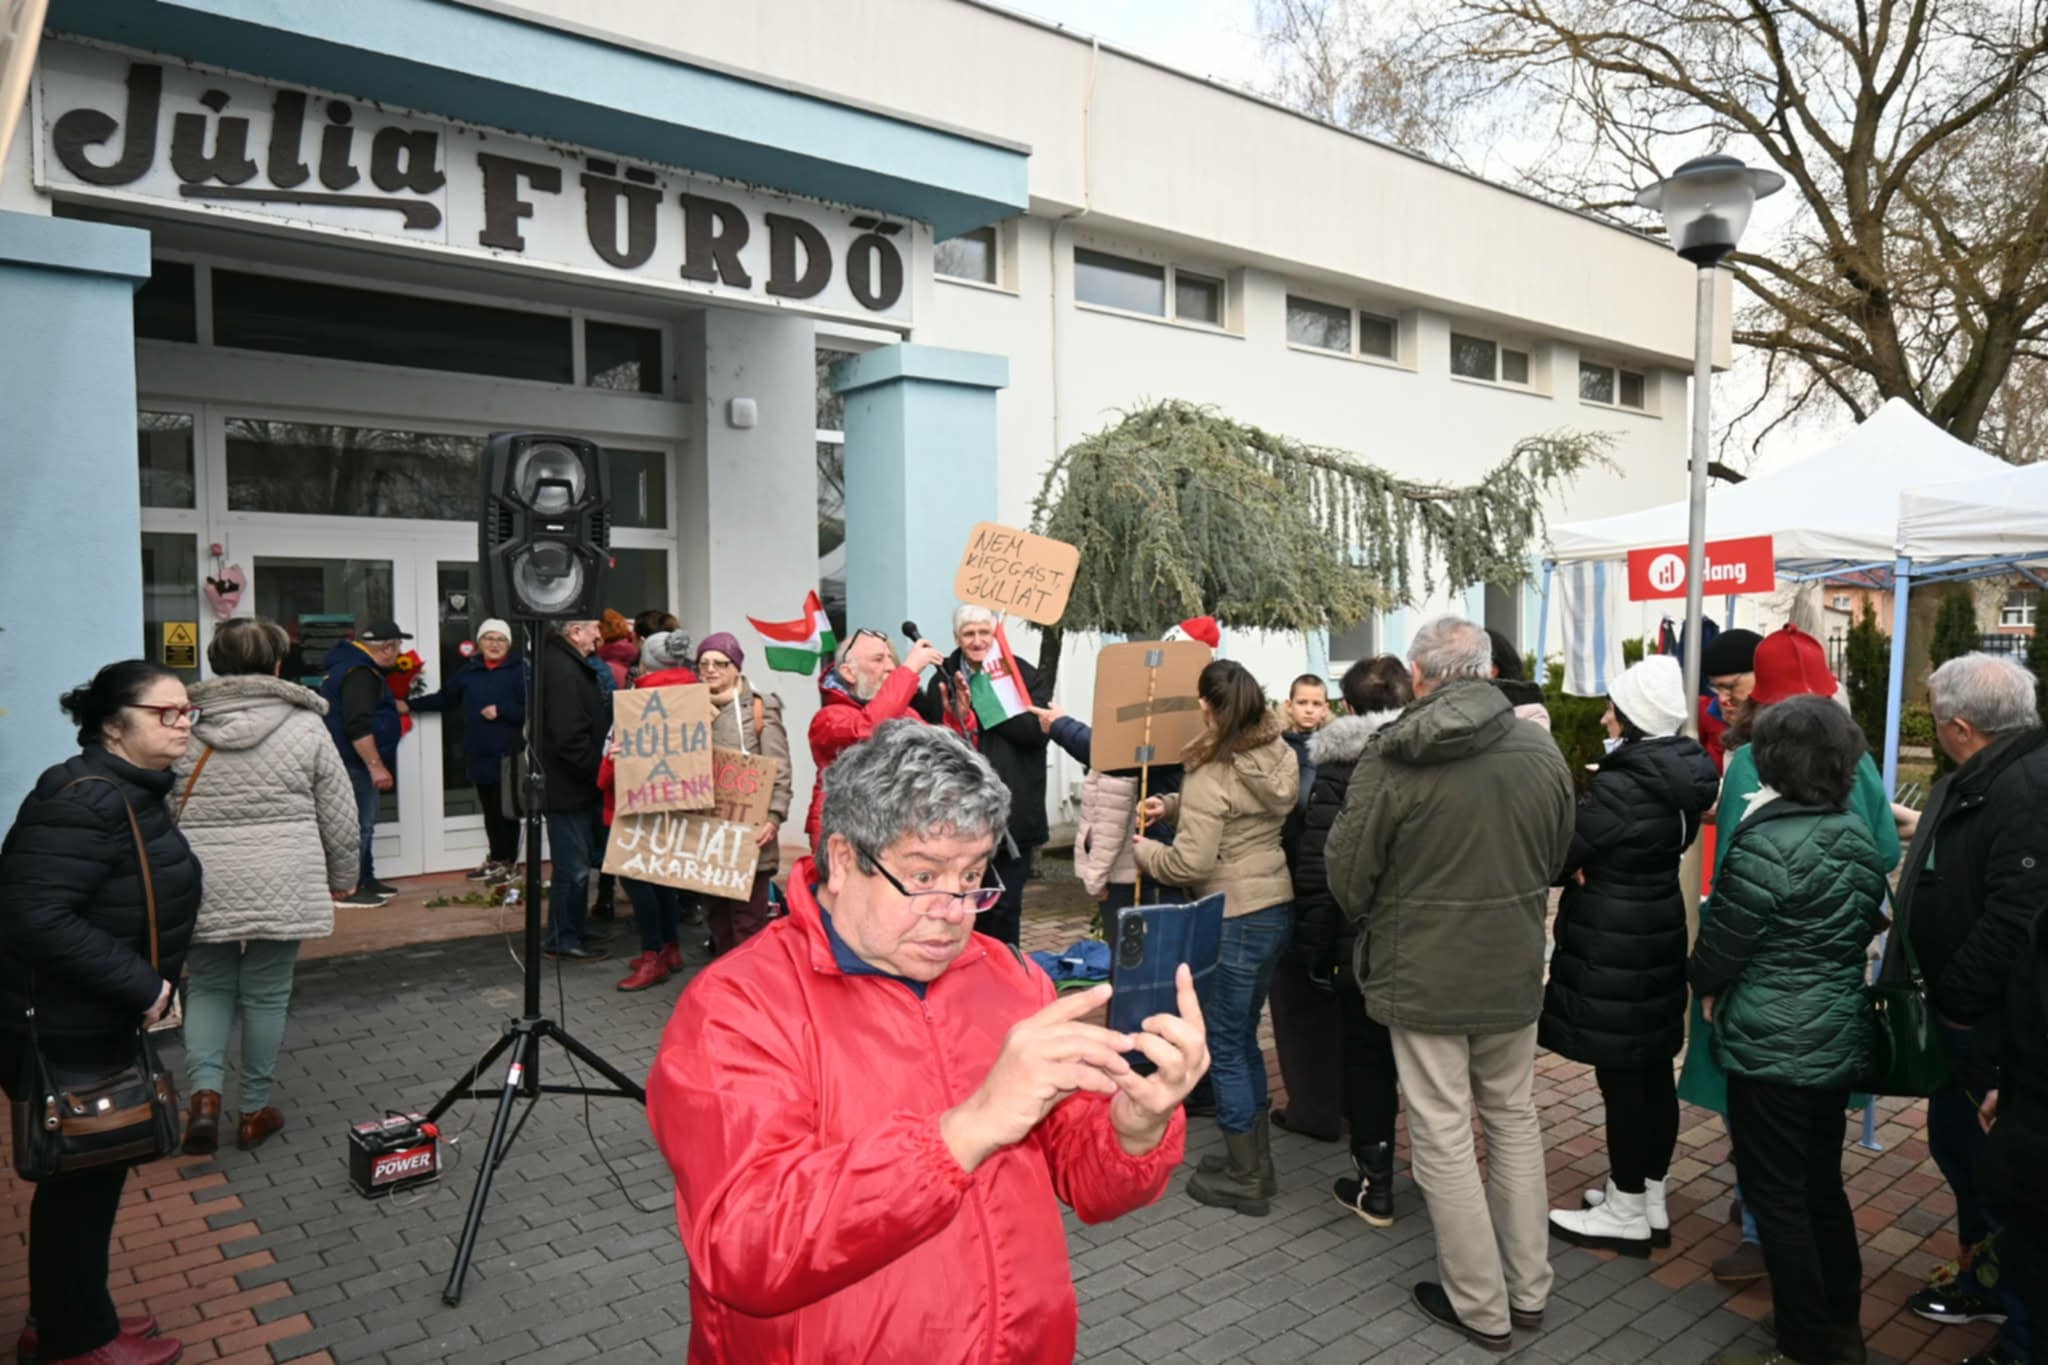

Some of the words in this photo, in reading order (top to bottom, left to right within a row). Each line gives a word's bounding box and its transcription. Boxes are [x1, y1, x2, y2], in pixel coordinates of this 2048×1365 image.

[52, 62, 447, 196] Júlia
[477, 152, 905, 312] FÜRDŐ
[973, 529, 1025, 558] NEM
[640, 689, 669, 721] A
[618, 719, 709, 760] JÚLIA
[647, 759, 677, 782] A
[374, 1152, 431, 1178] POWER
